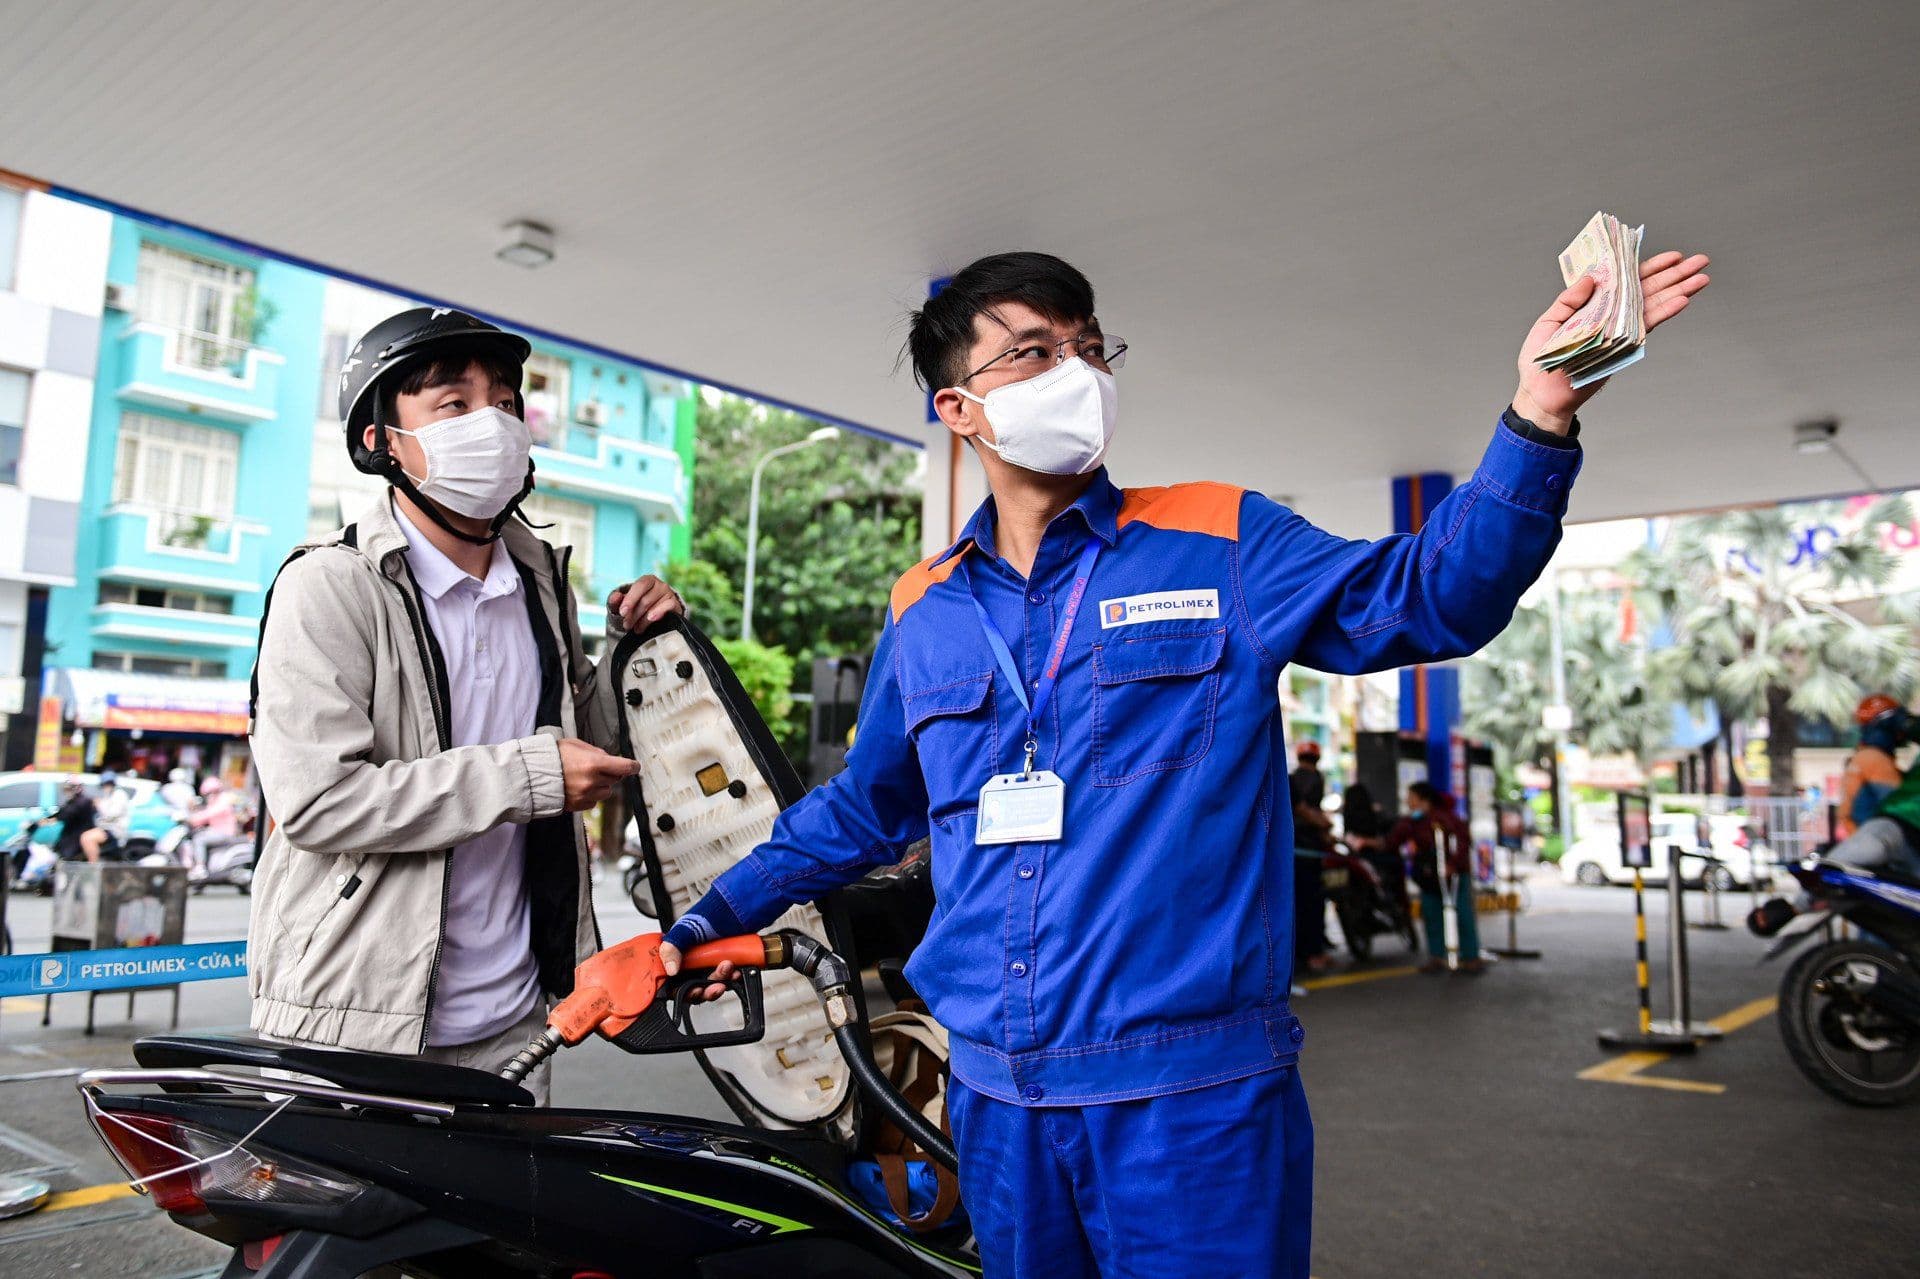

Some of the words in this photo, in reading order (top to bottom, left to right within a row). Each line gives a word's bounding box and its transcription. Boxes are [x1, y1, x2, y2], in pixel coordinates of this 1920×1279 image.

[1129, 599, 1214, 613] PETROLIMEX
[81, 957, 186, 978] PETROLIMEX
[198, 951, 232, 970] CỬA
[732, 1218, 763, 1234] FI
